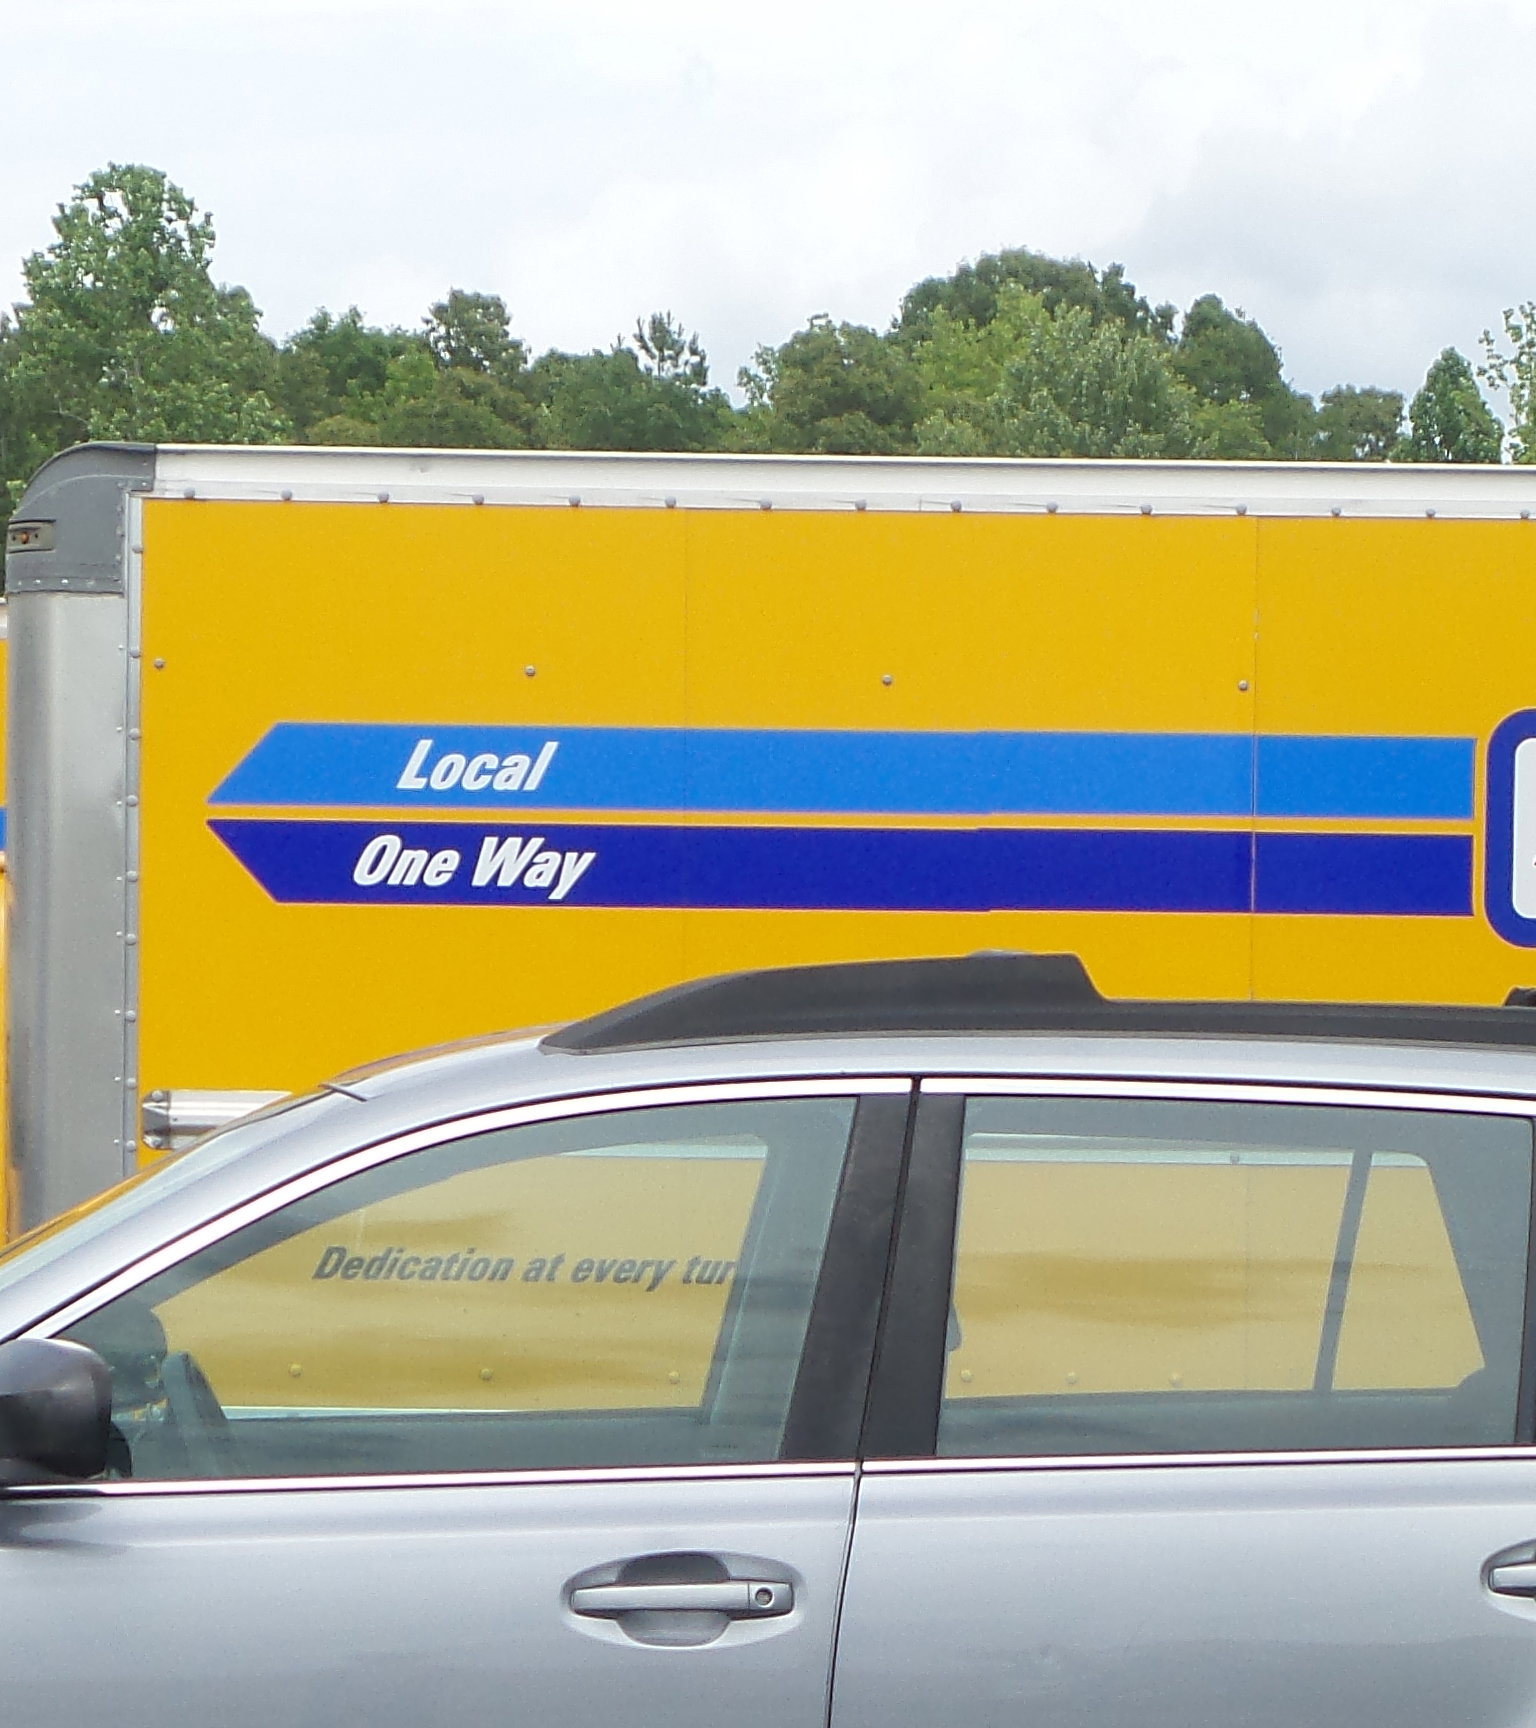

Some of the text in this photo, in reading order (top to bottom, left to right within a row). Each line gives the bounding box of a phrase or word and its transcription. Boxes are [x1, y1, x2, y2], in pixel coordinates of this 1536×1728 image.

[395, 738, 560, 791] Local
[352, 833, 597, 900] One Way
[312, 1245, 737, 1292] Dedication at every tur
